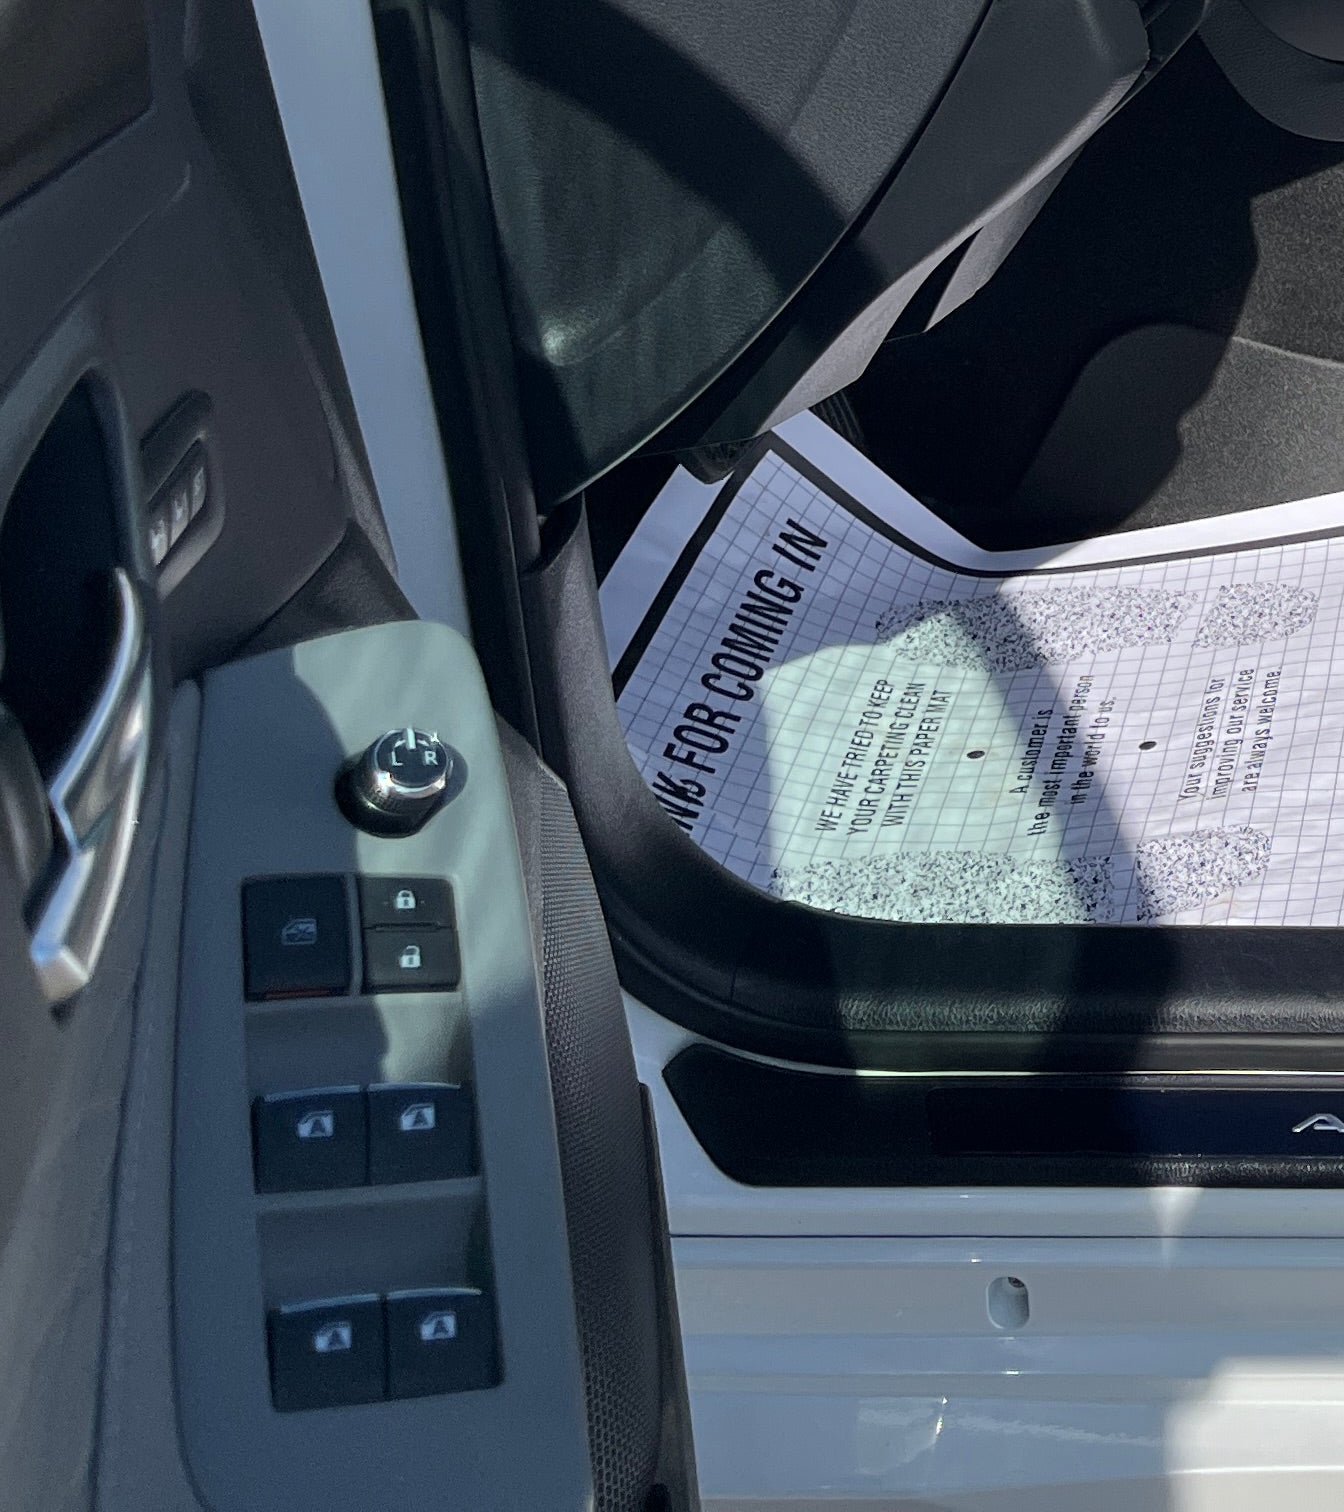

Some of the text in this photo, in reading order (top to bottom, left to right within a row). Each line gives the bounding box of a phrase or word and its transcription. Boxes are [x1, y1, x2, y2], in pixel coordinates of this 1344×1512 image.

[772, 518, 828, 572] IN
[701, 570, 804, 701] COMING
[391, 751, 439, 766] L R
[663, 702, 742, 774] FOR
[815, 679, 895, 831] WE HAVE TRIED TO KEEP
[847, 682, 926, 836] YOUR CARPETING CLEAN
[881, 689, 951, 827] WITH THIS PAPER MAT
[1009, 709, 1053, 793] A customer is
[1027, 675, 1094, 836] the most important person
[1064, 697, 1116, 804] in the world to us.
[1177, 678, 1225, 802] Your suggestions for
[1206, 669, 1254, 800] improving our service
[1242, 666, 1282, 792] are always welcome.
